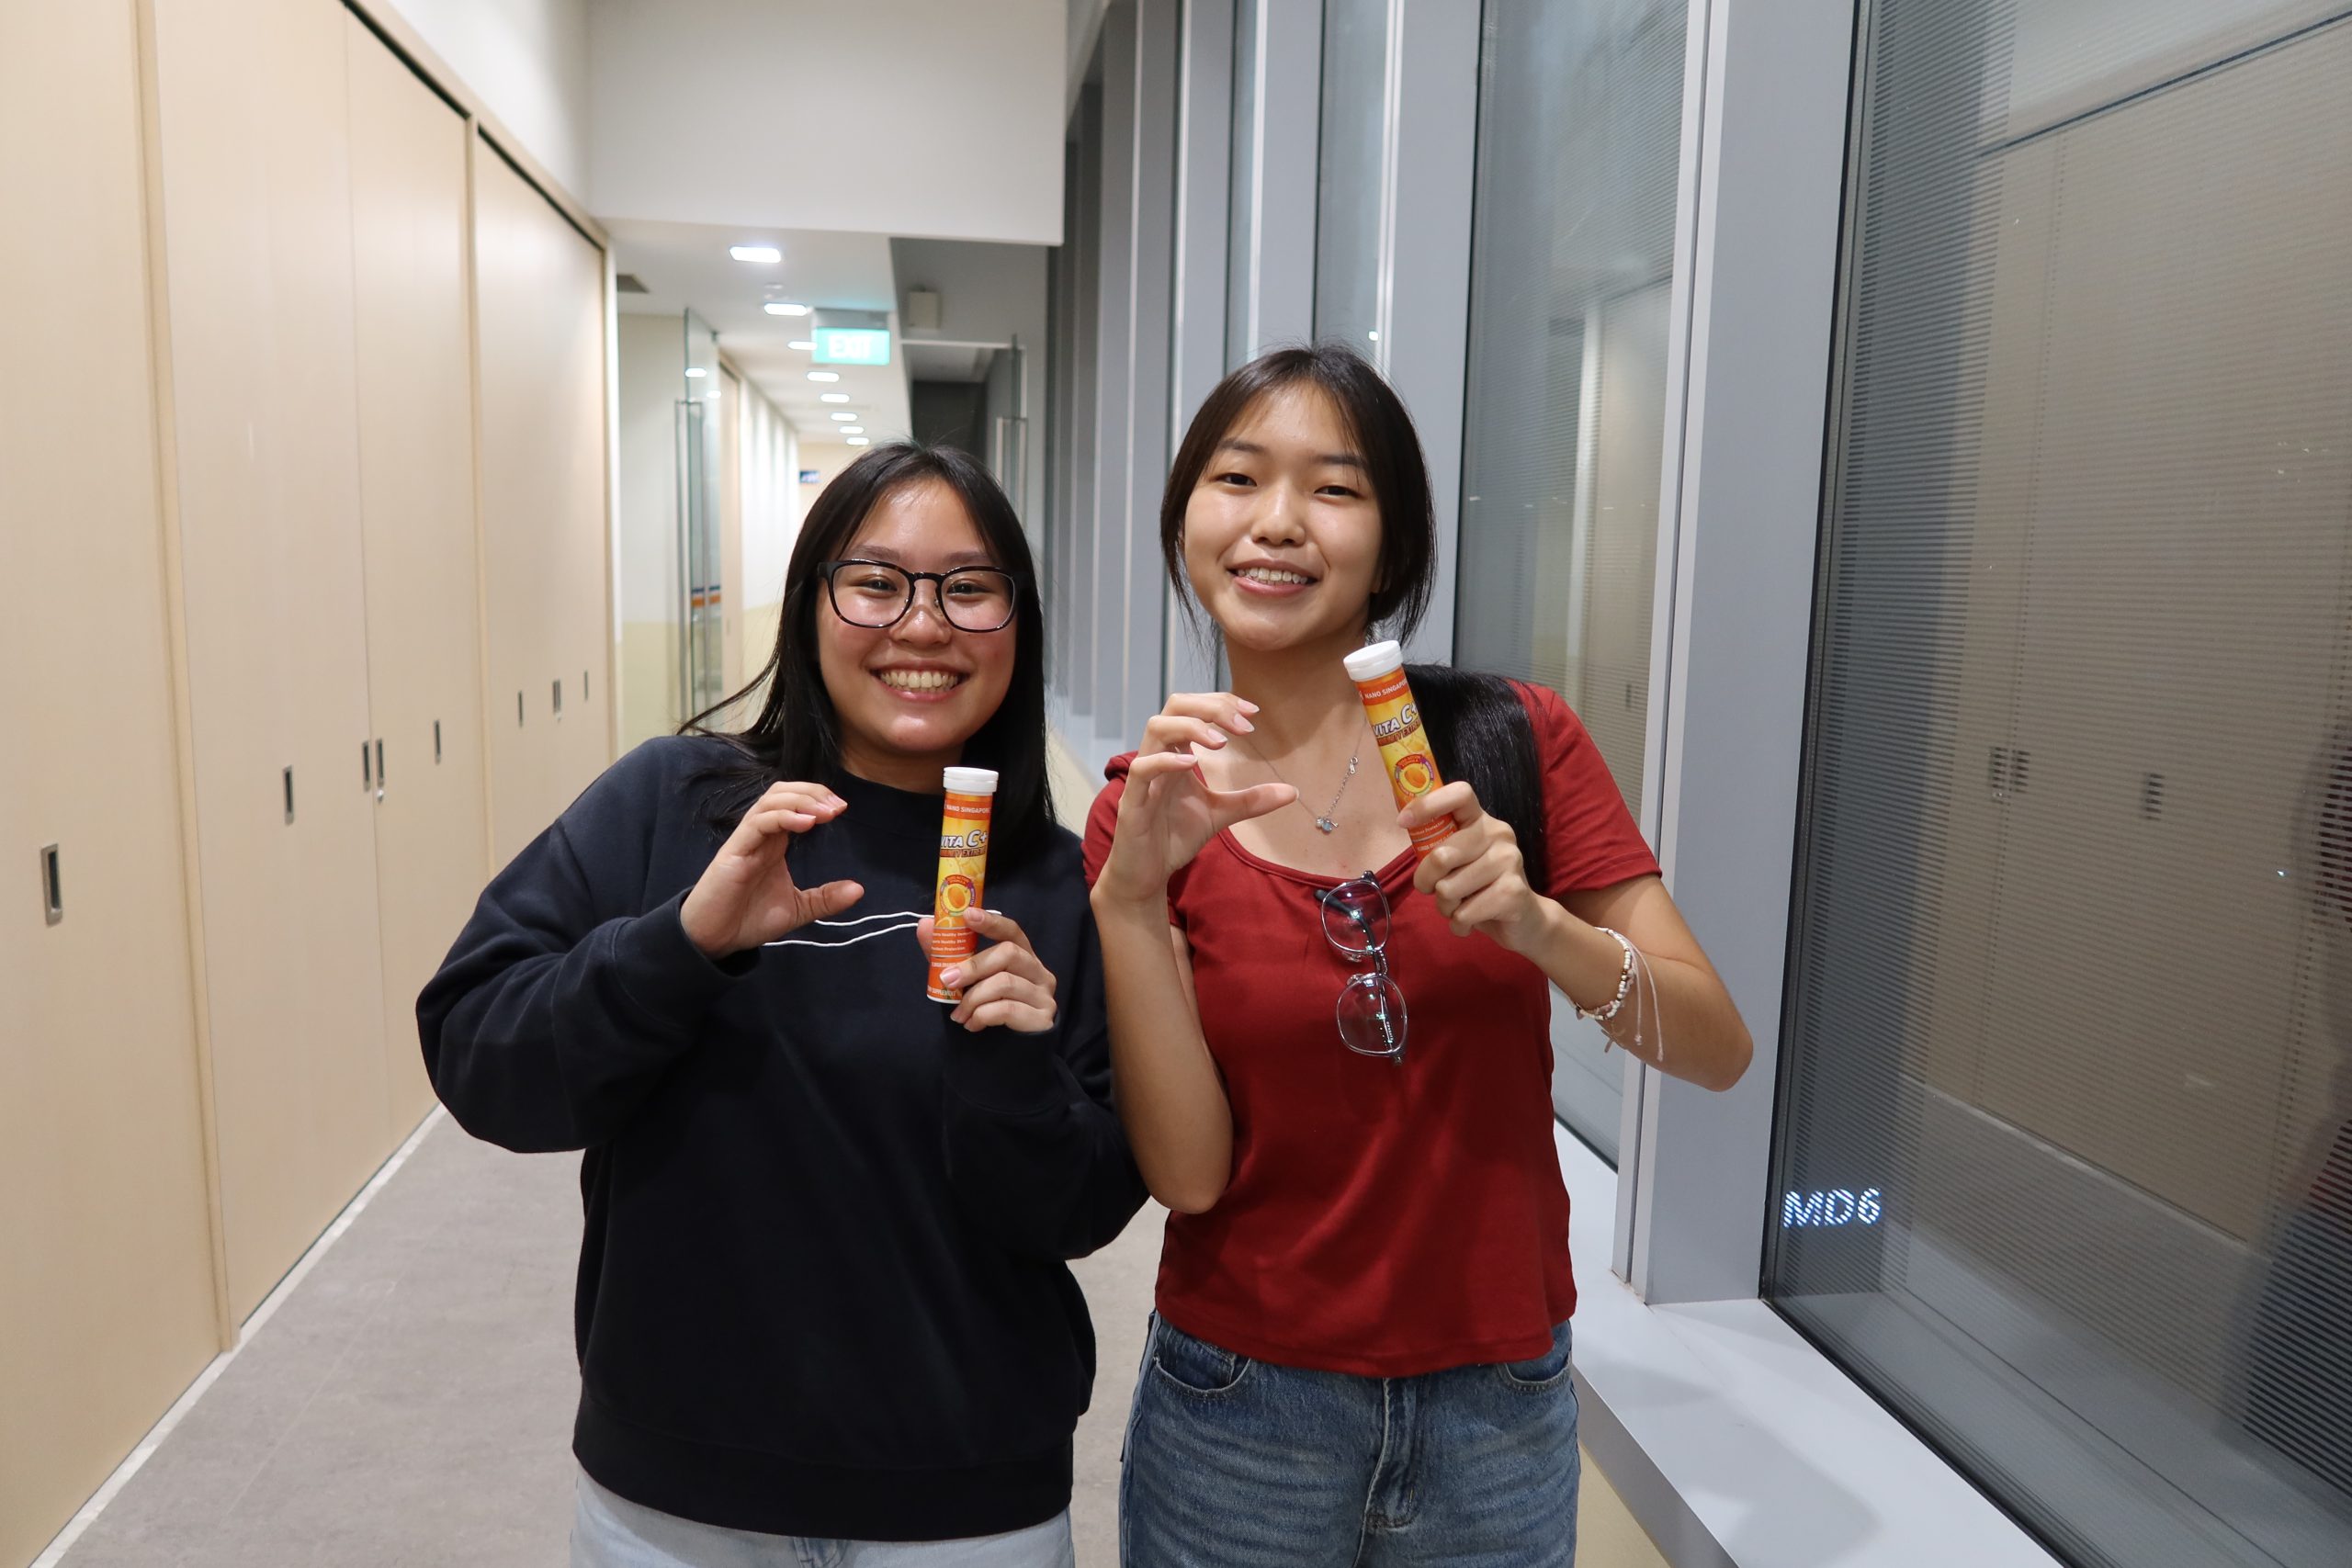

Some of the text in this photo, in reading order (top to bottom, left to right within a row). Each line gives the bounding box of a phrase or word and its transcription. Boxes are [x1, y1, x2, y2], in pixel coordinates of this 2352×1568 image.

[829, 333, 874, 358] EXIT
[1364, 690, 1382, 699] NANO
[1373, 717, 1401, 737] VITA
[940, 829, 989, 848] VITA C+
[1783, 1187, 1881, 1229] MD6
